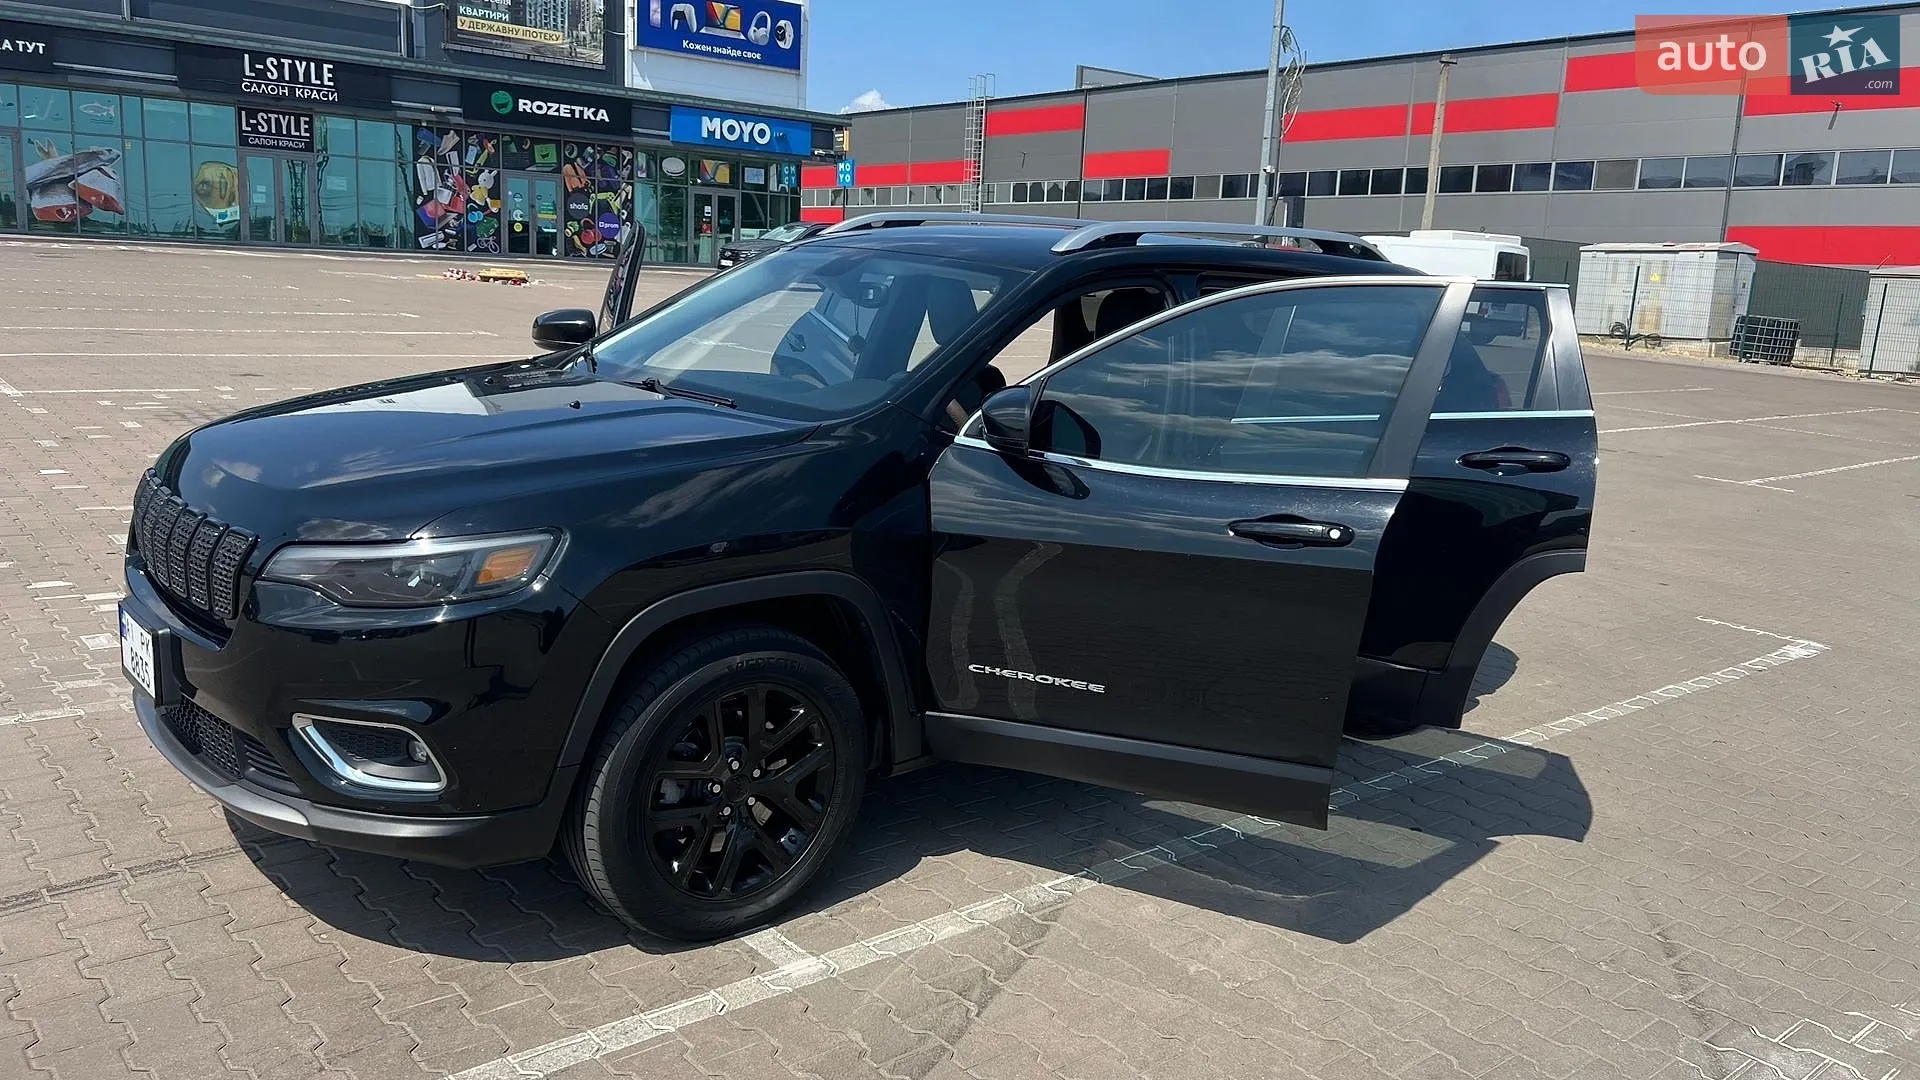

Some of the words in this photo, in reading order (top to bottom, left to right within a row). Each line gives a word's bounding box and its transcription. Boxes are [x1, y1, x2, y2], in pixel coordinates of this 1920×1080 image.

[459, 5, 509, 21] КВАРТИРИ
[459, 19, 466, 27] У
[468, 21, 520, 36] ДЕРЖАВНУ
[522, 29, 561, 42] ІПОТЕКУ
[15, 40, 46, 54] ТУТ
[682, 39, 712, 53] Кожен
[712, 46, 742, 58] знайде
[742, 51, 762, 60] своє
[243, 53, 335, 86] L-STYLE
[241, 82, 289, 96] САЛОН
[295, 87, 338, 102] КРАСИ
[518, 99, 610, 122] ROZETKA
[241, 110, 310, 137] L-STYLE
[701, 116, 771, 145] MOYO
[248, 137, 278, 147] САЛОН
[278, 139, 306, 149] КРАСИ
[838, 162, 851, 172] MO
[839, 174, 851, 183] YO
[569, 202, 588, 210] shafa
[968, 663, 1106, 693] CHEROKEE
